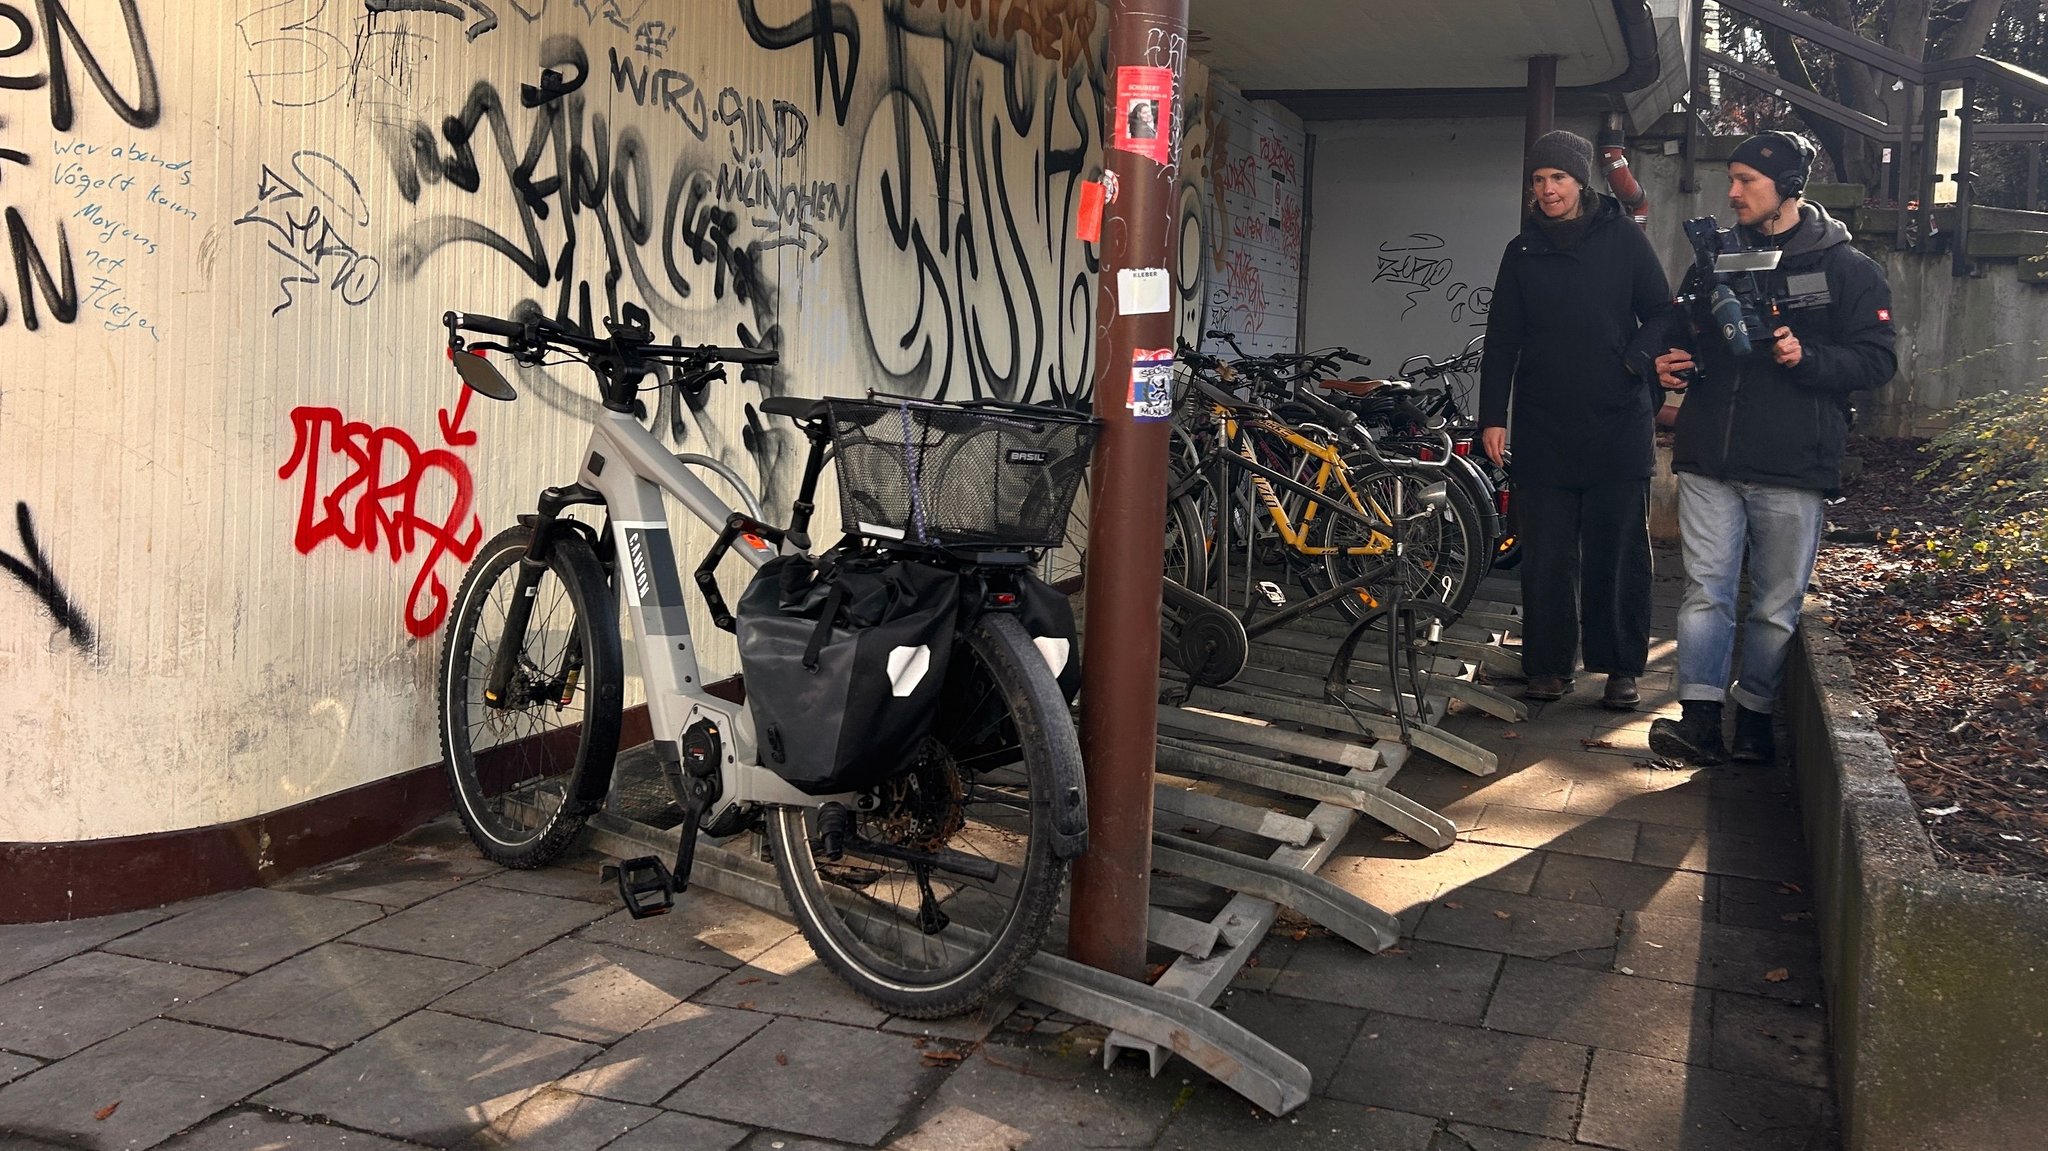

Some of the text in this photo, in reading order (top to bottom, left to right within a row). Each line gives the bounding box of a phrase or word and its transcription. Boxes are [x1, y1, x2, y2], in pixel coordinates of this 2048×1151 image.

[609, 46, 809, 164] WIR SIND
[714, 156, 851, 232] MÜNCHEN
[1011, 452, 1044, 461] BASIL
[629, 532, 650, 599] CANYON
